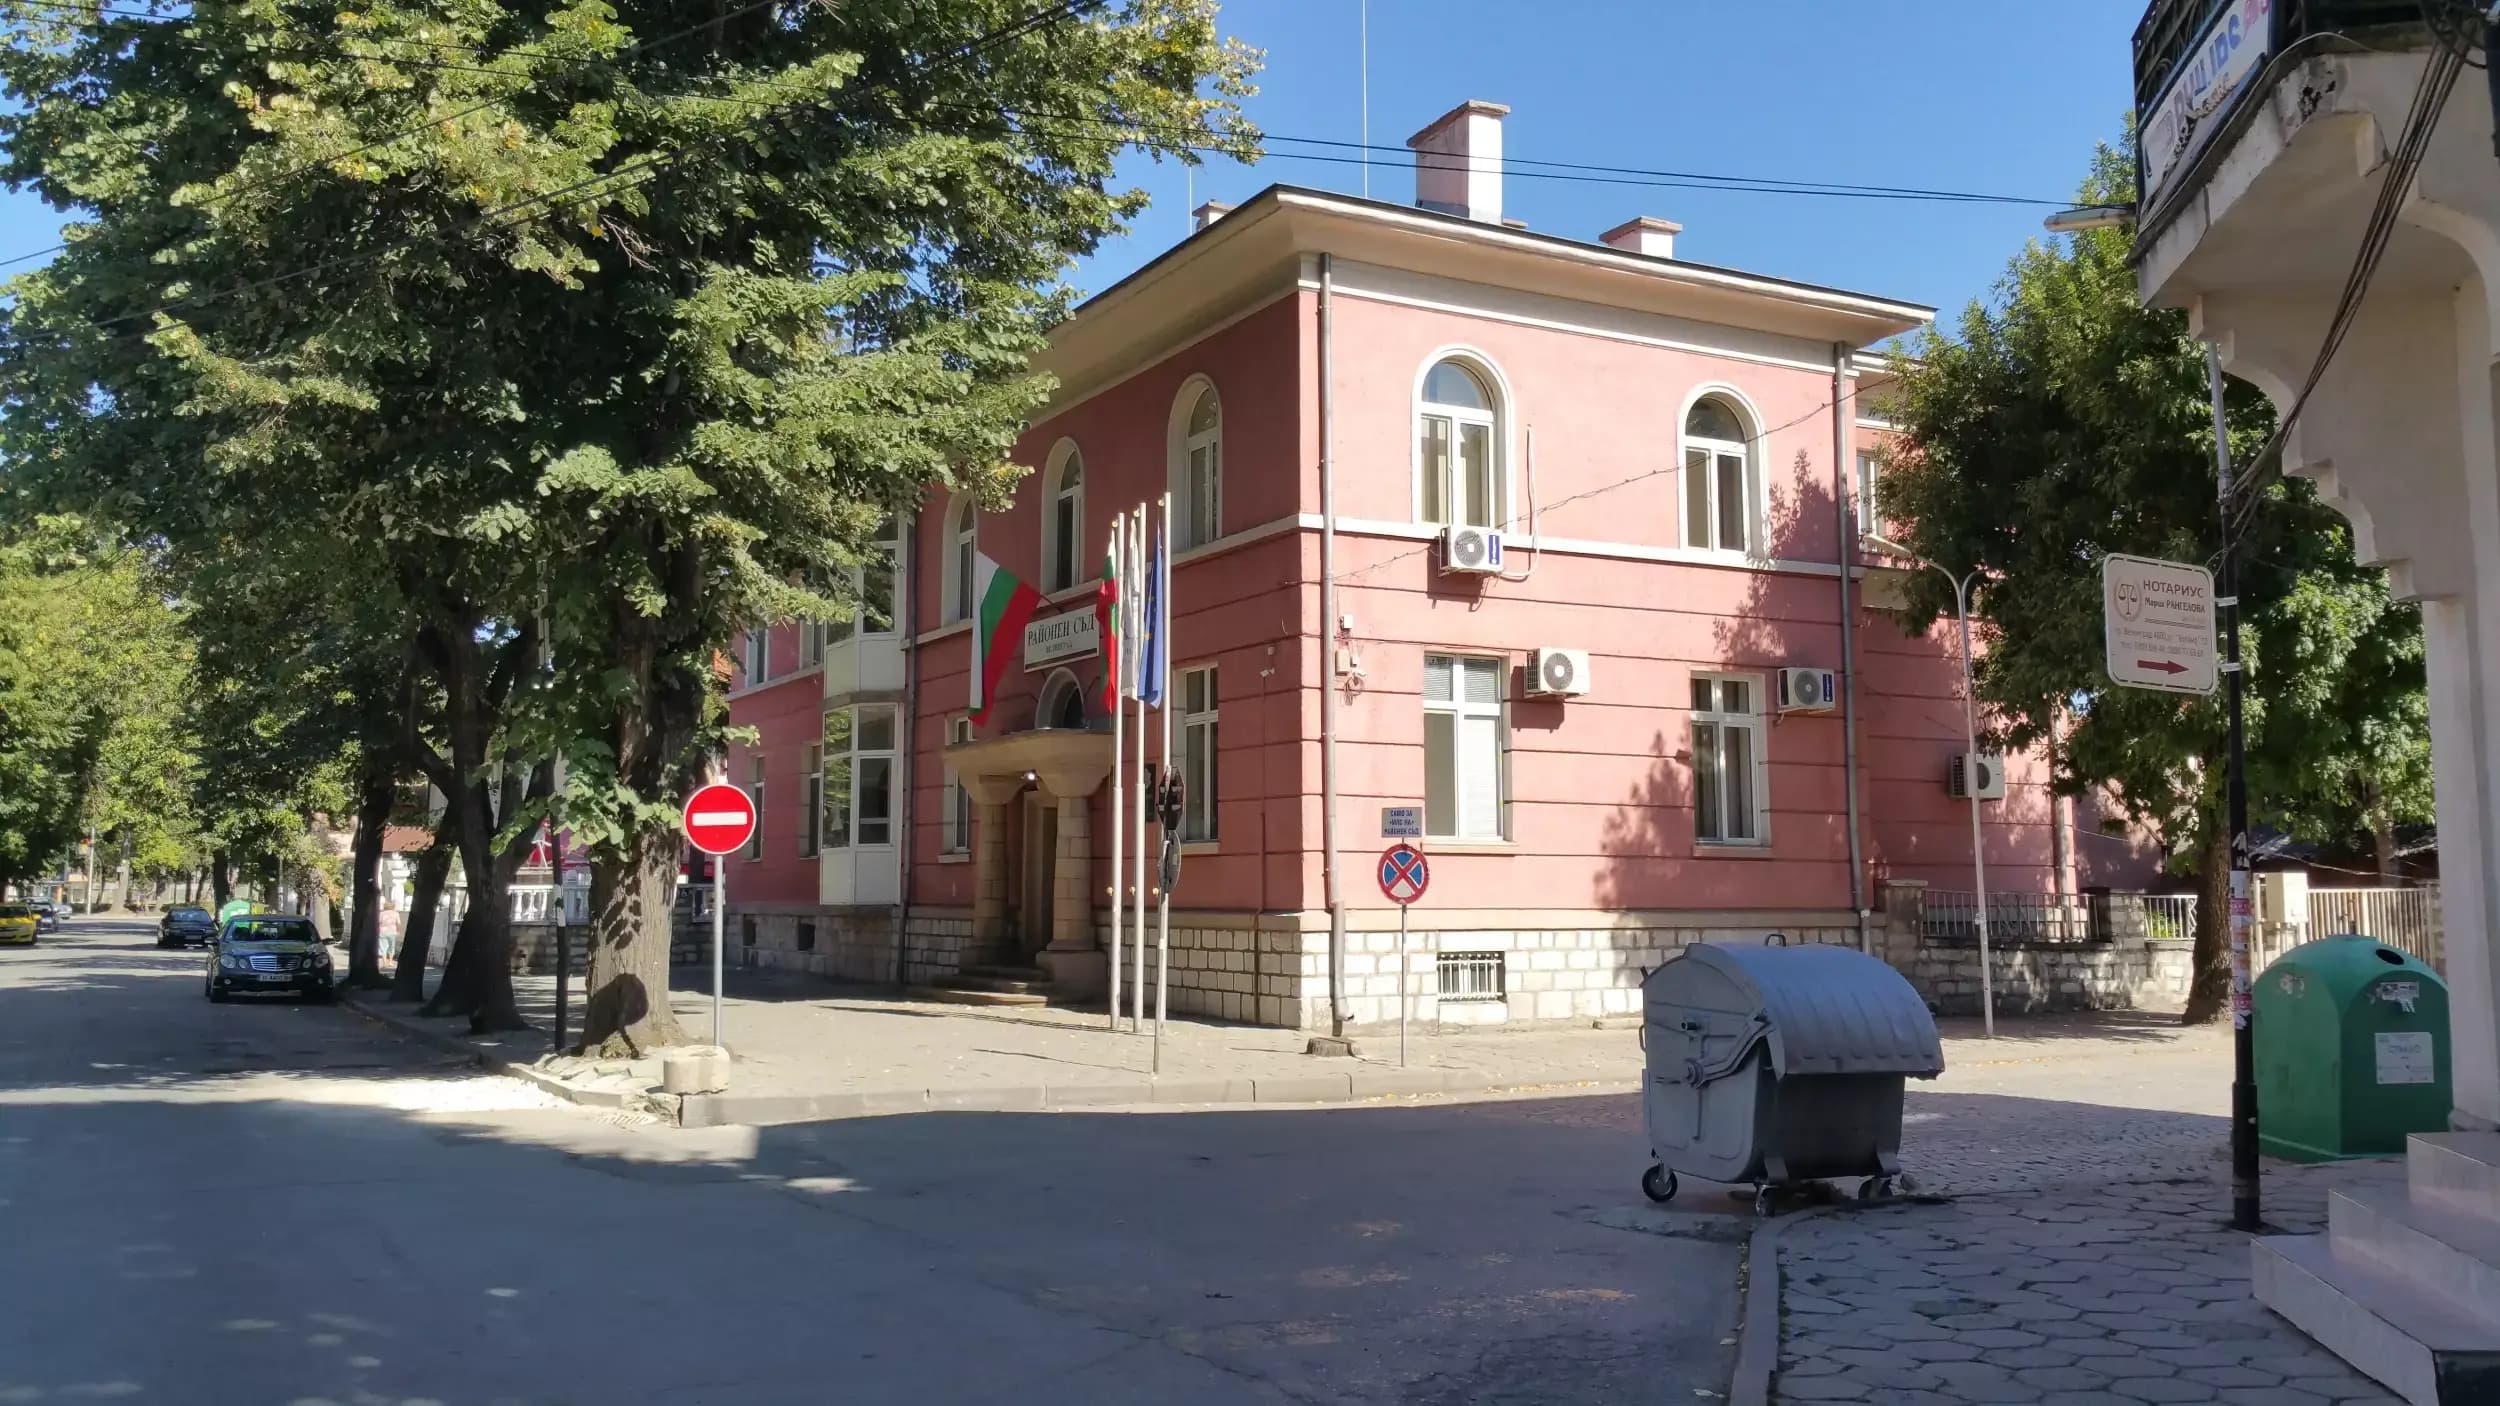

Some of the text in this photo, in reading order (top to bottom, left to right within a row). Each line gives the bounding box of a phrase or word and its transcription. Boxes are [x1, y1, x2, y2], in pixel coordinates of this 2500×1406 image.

[2143, 579, 2204, 598] НОТАРИУС
[2144, 597, 2165, 609] Мария
[1028, 613, 1095, 646] РАЙОНЕН СЪД
